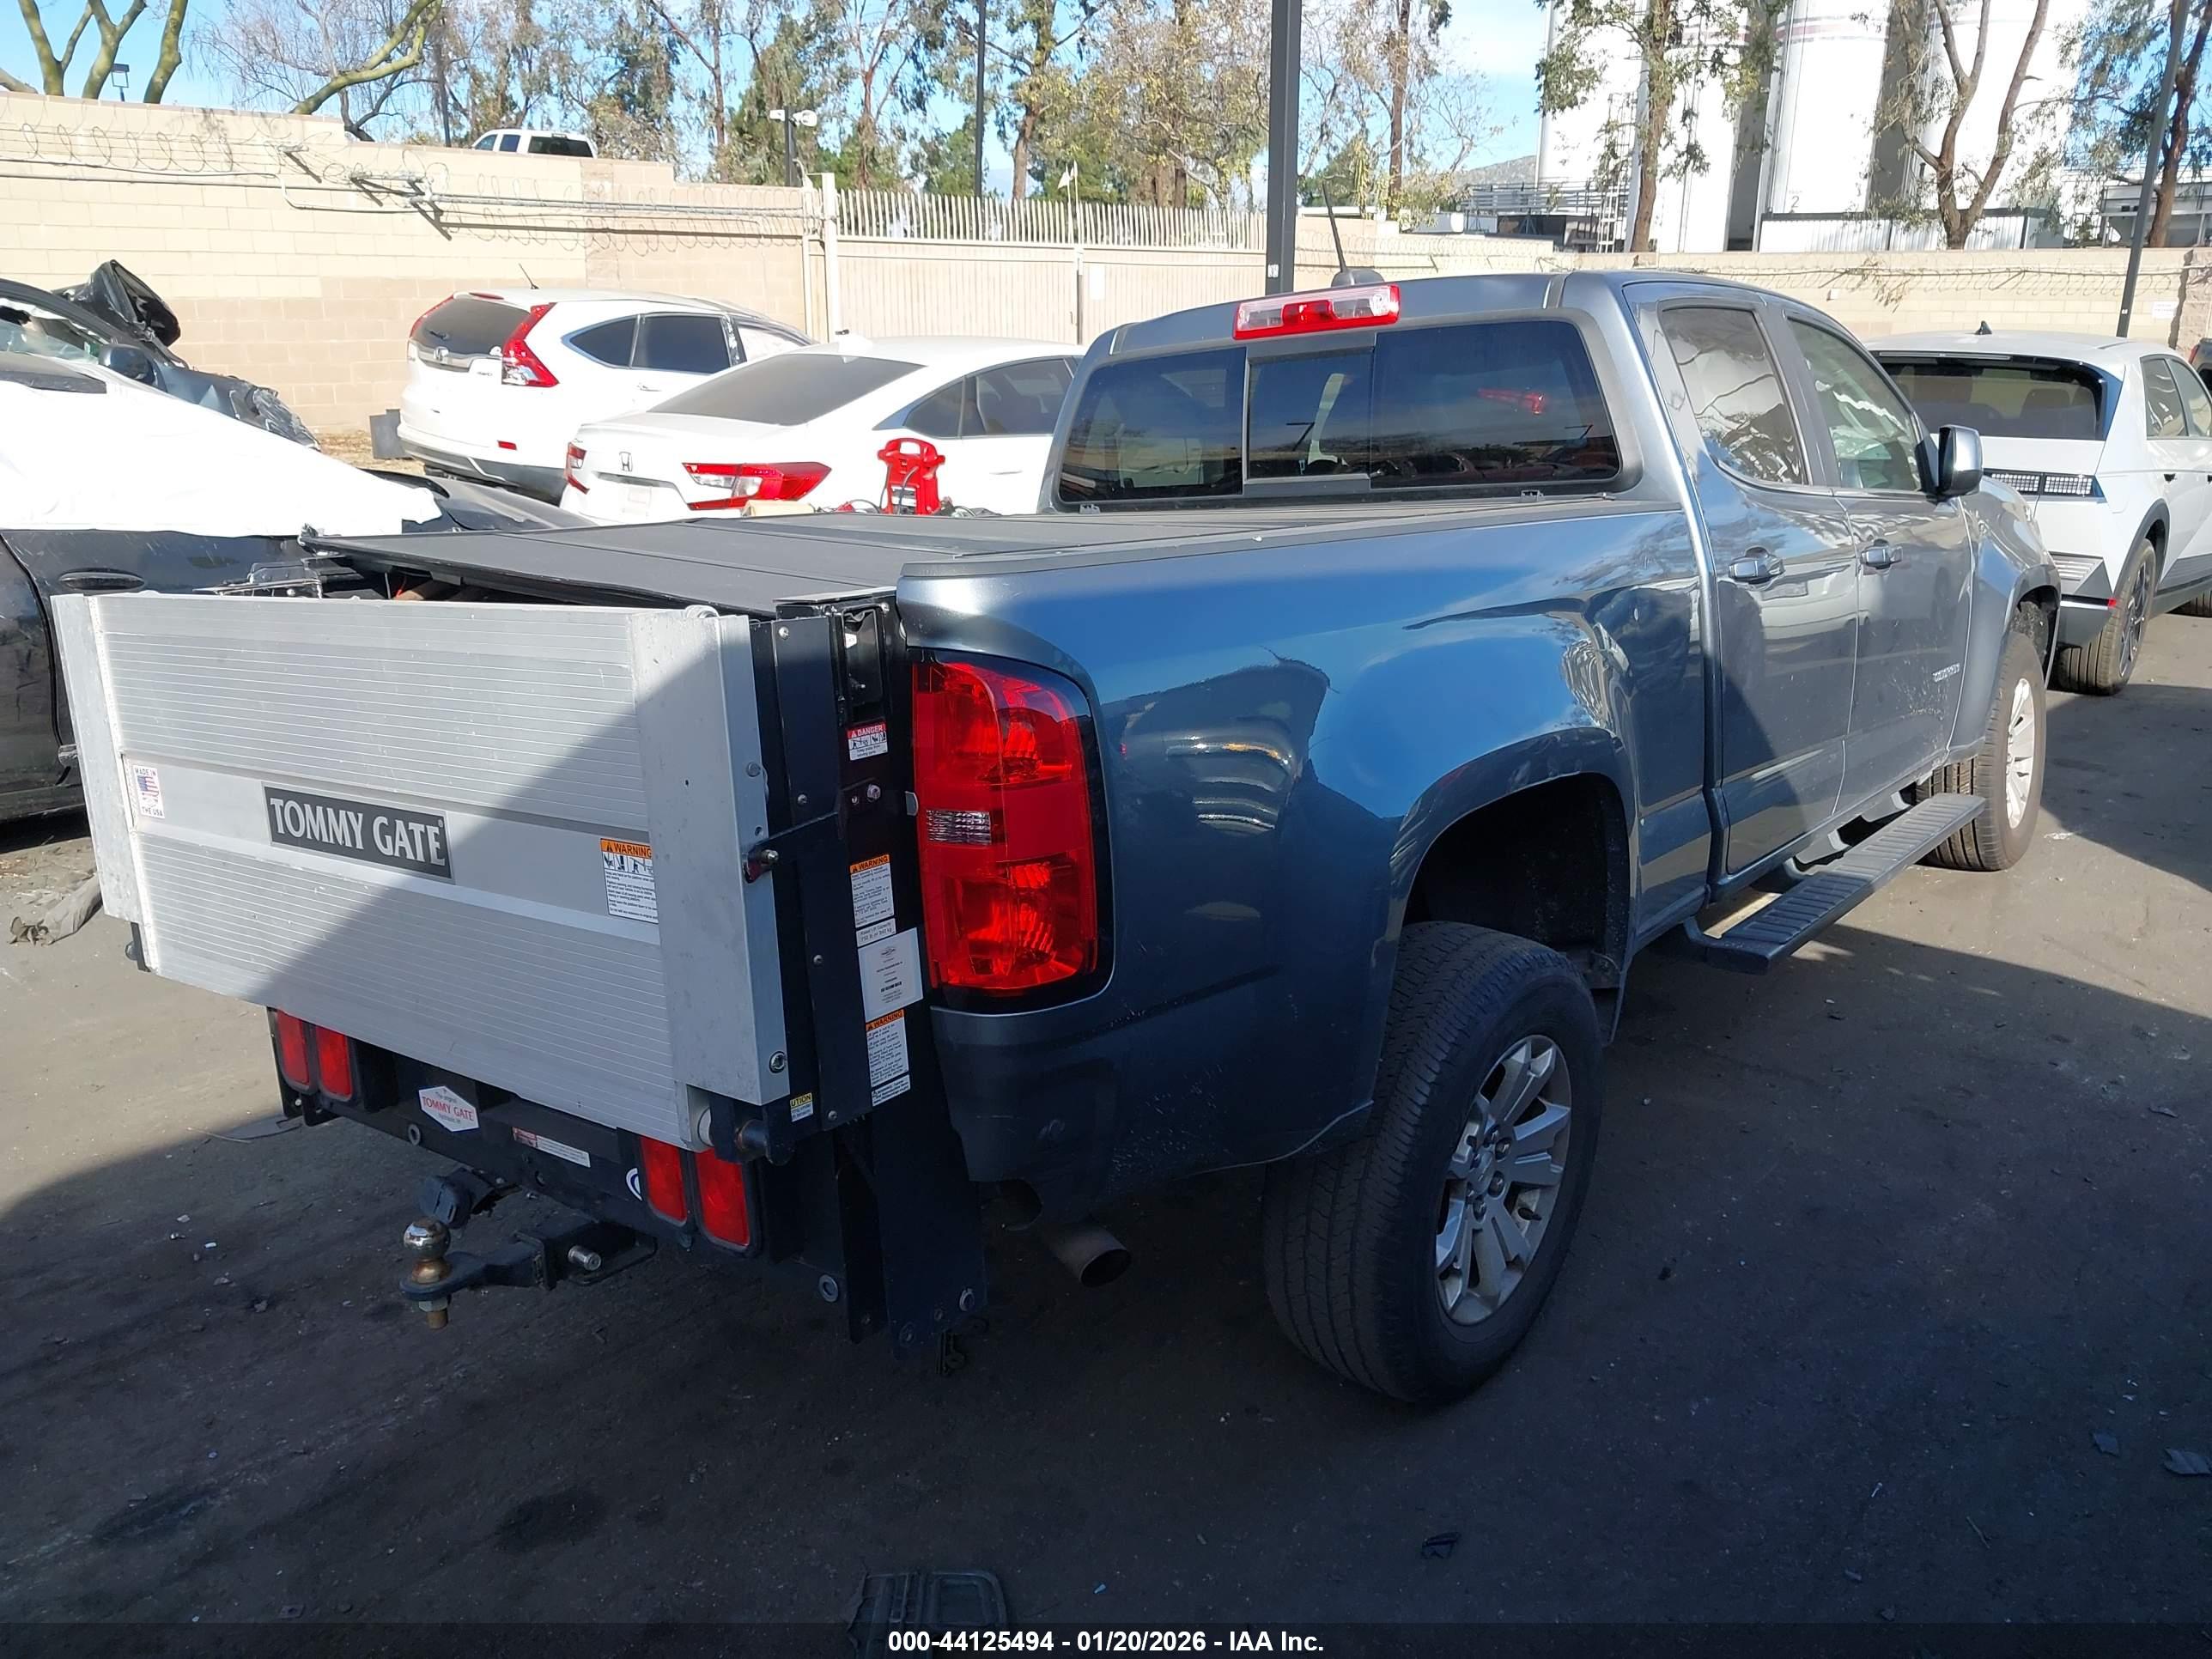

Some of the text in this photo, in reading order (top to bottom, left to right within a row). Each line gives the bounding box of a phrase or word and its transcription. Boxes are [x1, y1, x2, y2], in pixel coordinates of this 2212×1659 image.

[857, 724, 884, 737] DANGER
[135, 768, 149, 776] MADE
[142, 805, 163, 817] THE USA
[270, 797, 446, 866] TOMMY GATE
[613, 842, 652, 857] WARNING
[859, 856, 889, 870] WARNING
[872, 1010, 902, 1026] WARNING
[791, 1093, 811, 1107] UTION
[422, 1096, 451, 1114] TOMMY
[453, 1106, 475, 1121] GATE
